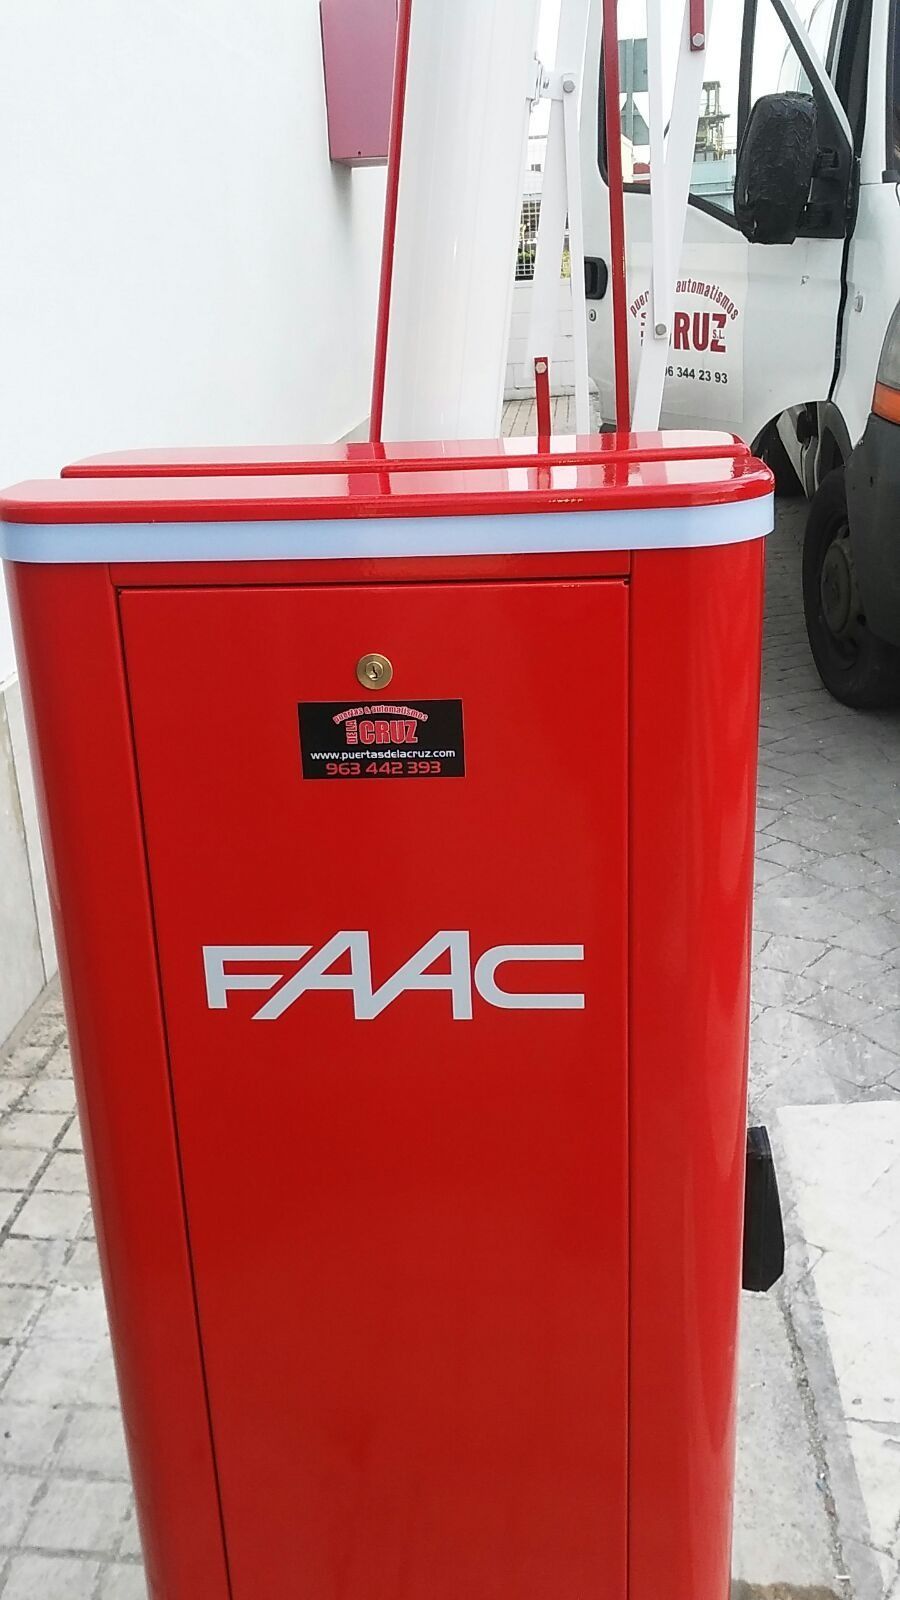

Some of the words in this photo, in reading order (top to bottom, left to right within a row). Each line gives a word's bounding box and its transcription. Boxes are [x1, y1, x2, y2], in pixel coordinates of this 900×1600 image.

[630, 290, 650, 318] puer
[675, 278, 739, 321] automatismos
[669, 311, 727, 353] RUZ
[712, 329, 725, 340] S.L.
[676, 366, 695, 379] 344
[698, 369, 711, 382] 23
[714, 371, 728, 384] 93
[371, 704, 429, 722] automatismos
[358, 720, 419, 744] CRUZ
[310, 750, 456, 761] www.puertasdelacruz.com
[325, 762, 361, 775] 963
[365, 762, 403, 775] 442
[407, 761, 441, 774] 393
[202, 930, 585, 1020] FAAC
